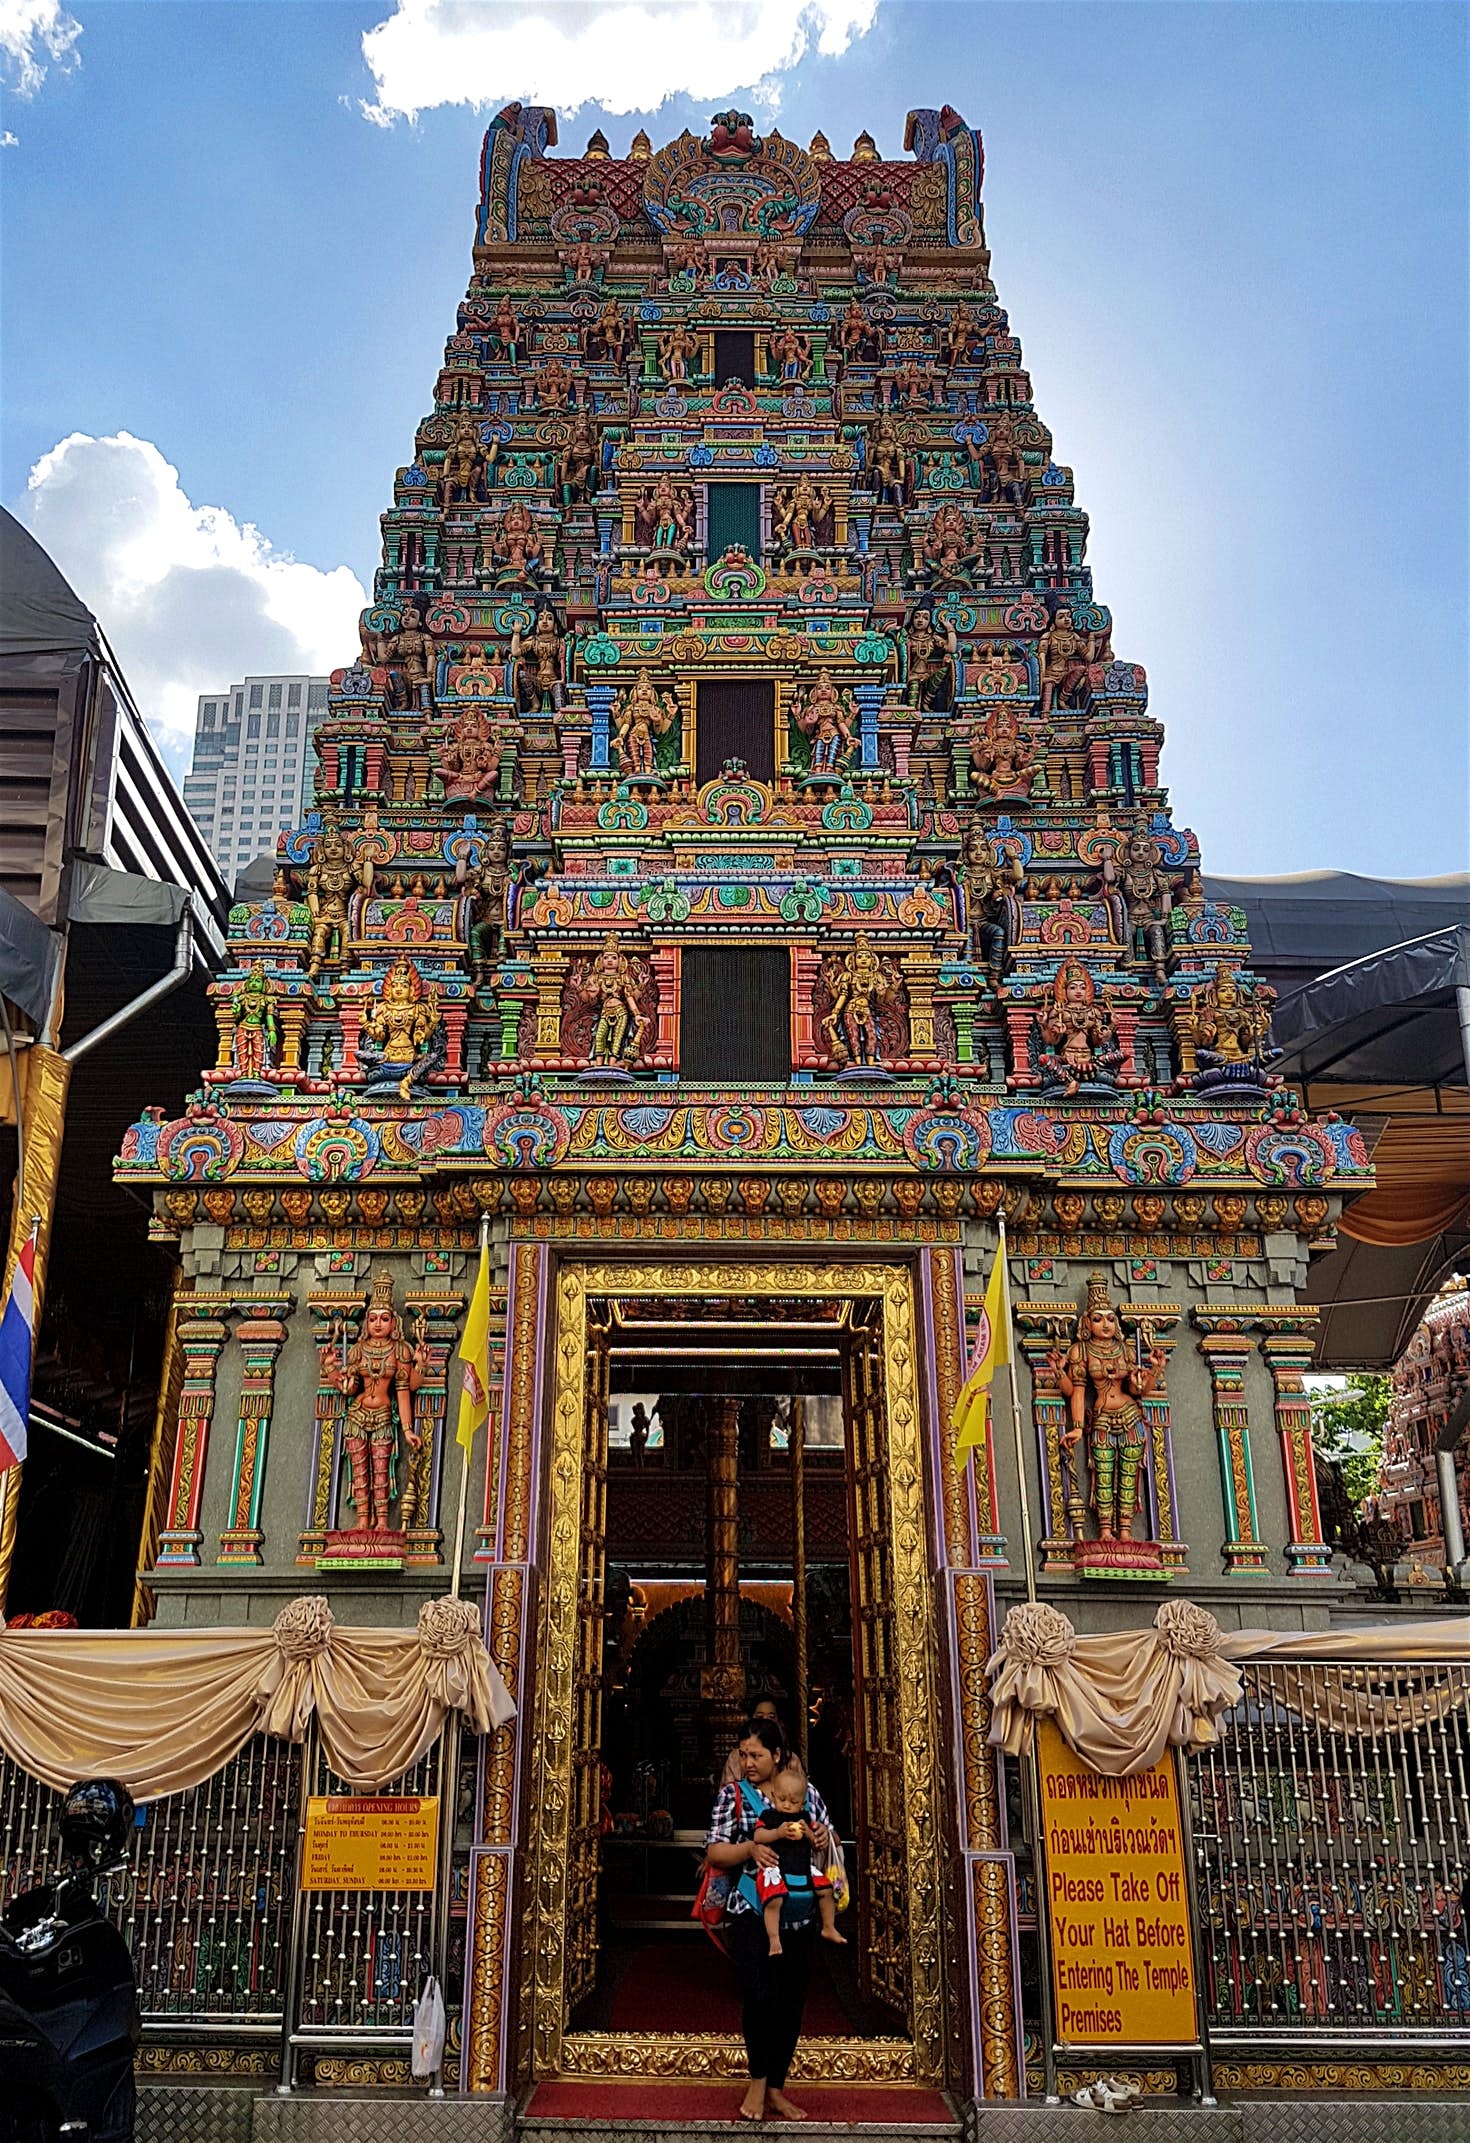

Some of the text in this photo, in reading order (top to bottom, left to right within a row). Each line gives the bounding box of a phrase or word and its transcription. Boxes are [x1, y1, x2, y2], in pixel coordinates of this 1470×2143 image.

[1052, 1872, 1180, 1902] Please Take Off
[1055, 1916, 1185, 1947] Your Hat Before
[1057, 1959, 1189, 1997] Entering The Temple
[1061, 2002, 1122, 2033] Premises
